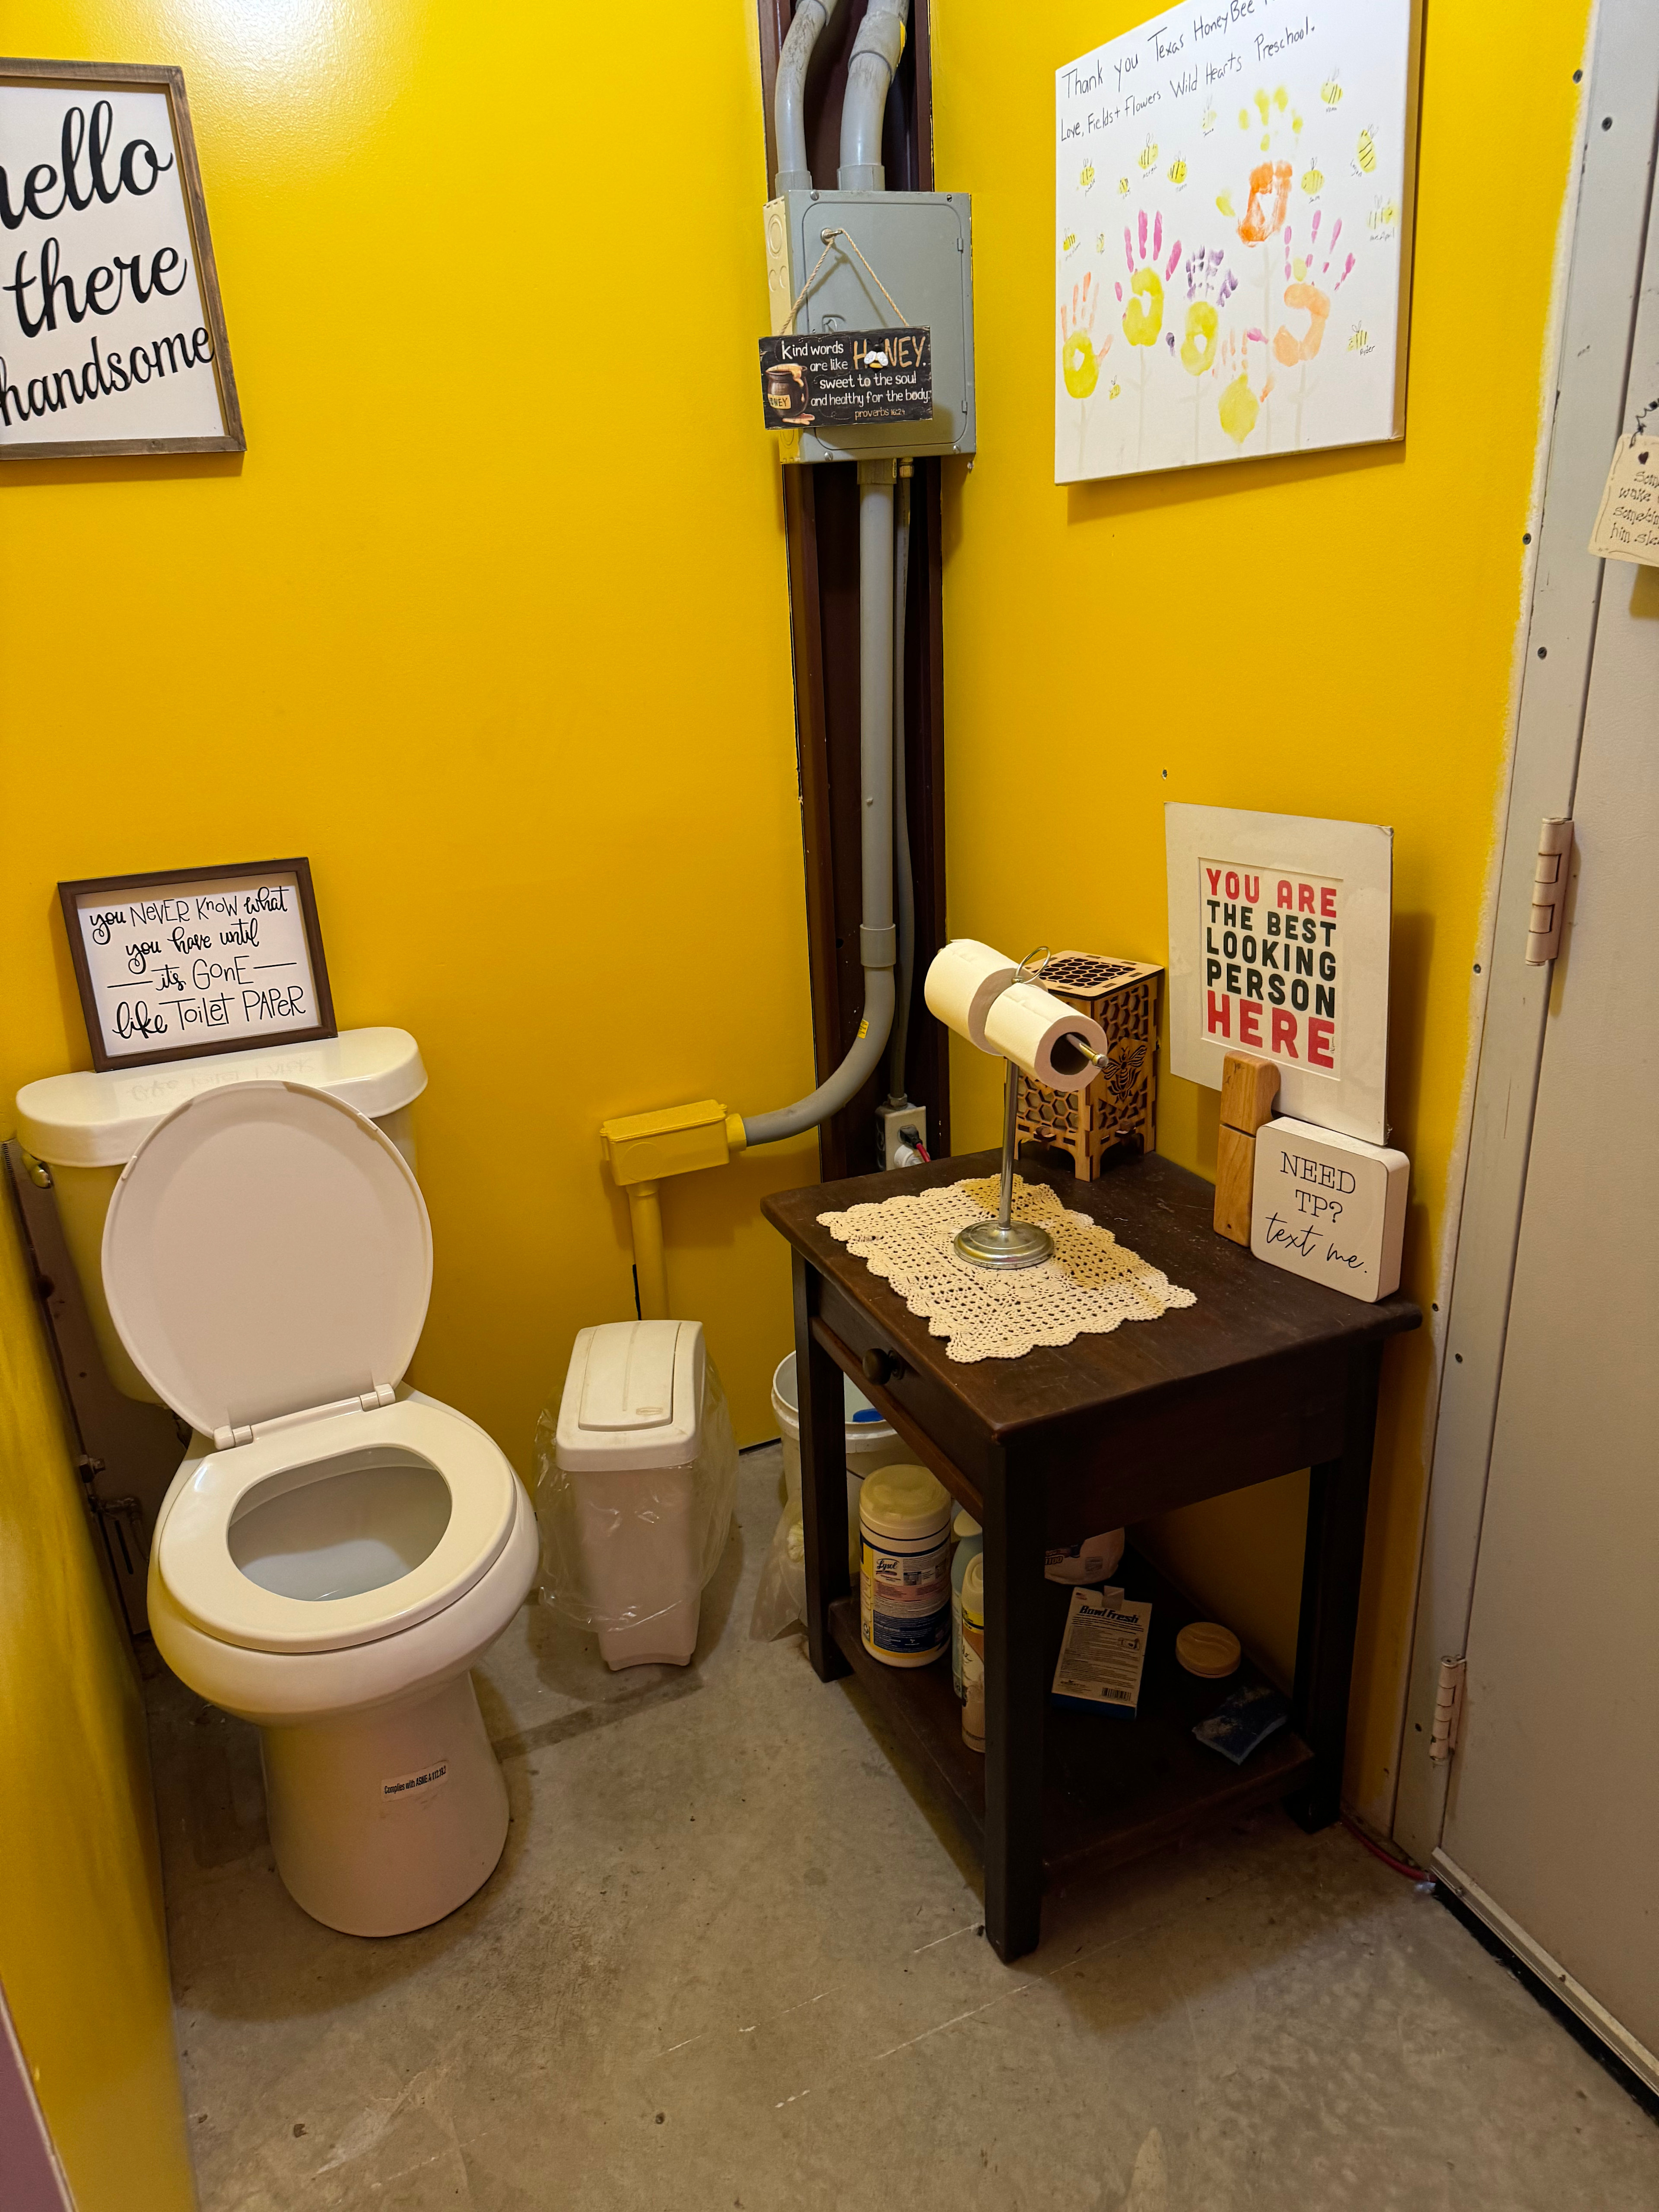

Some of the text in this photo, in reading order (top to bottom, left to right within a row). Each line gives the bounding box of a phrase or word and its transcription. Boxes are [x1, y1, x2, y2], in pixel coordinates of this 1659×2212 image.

[1061, 118, 1084, 142] Love,
[1125, 91, 1161, 117] Flowers
[1170, 64, 1198, 98] Wild
[1206, 52, 1242, 85] Hearts
[1254, 16, 1316, 61] Preschool.
[1062, 59, 1103, 99] Thank
[1114, 53, 1138, 92] you
[1147, 27, 1185, 61] Texas
[3, 237, 187, 337] there
[810, 340, 844, 356] words
[810, 336, 926, 372] are like HNEY.
[0, 327, 215, 426] handsome
[819, 371, 916, 389] sweet to the soul
[810, 394, 828, 406] and
[830, 392, 864, 407] healthy
[866, 391, 883, 403] for
[886, 390, 903, 402] the
[855, 407, 889, 420] proverbs
[1618, 487, 1651, 502] wake
[1610, 522, 1630, 543] him
[1206, 868, 1337, 918] YOU ARE
[90, 910, 127, 944] you
[244, 886, 289, 914] what
[1207, 900, 1336, 947] THE BEST
[126, 918, 259, 974] you have until
[1207, 927, 1336, 982] LOOKING
[1207, 958, 1335, 1019] PERSON
[112, 1001, 168, 1039] like
[1208, 990, 1335, 1069] HERE
[1280, 1151, 1356, 1194] NEED
[1295, 1189, 1343, 1223] TP?
[1265, 1212, 1367, 1273] text me.
[877, 1560, 898, 1571] Lysol
[1080, 1605, 1139, 1624] Bowl Fresh
[384, 1783, 405, 1794] Complies
[406, 1780, 415, 1789] with
[416, 1774, 428, 1786] ASME
